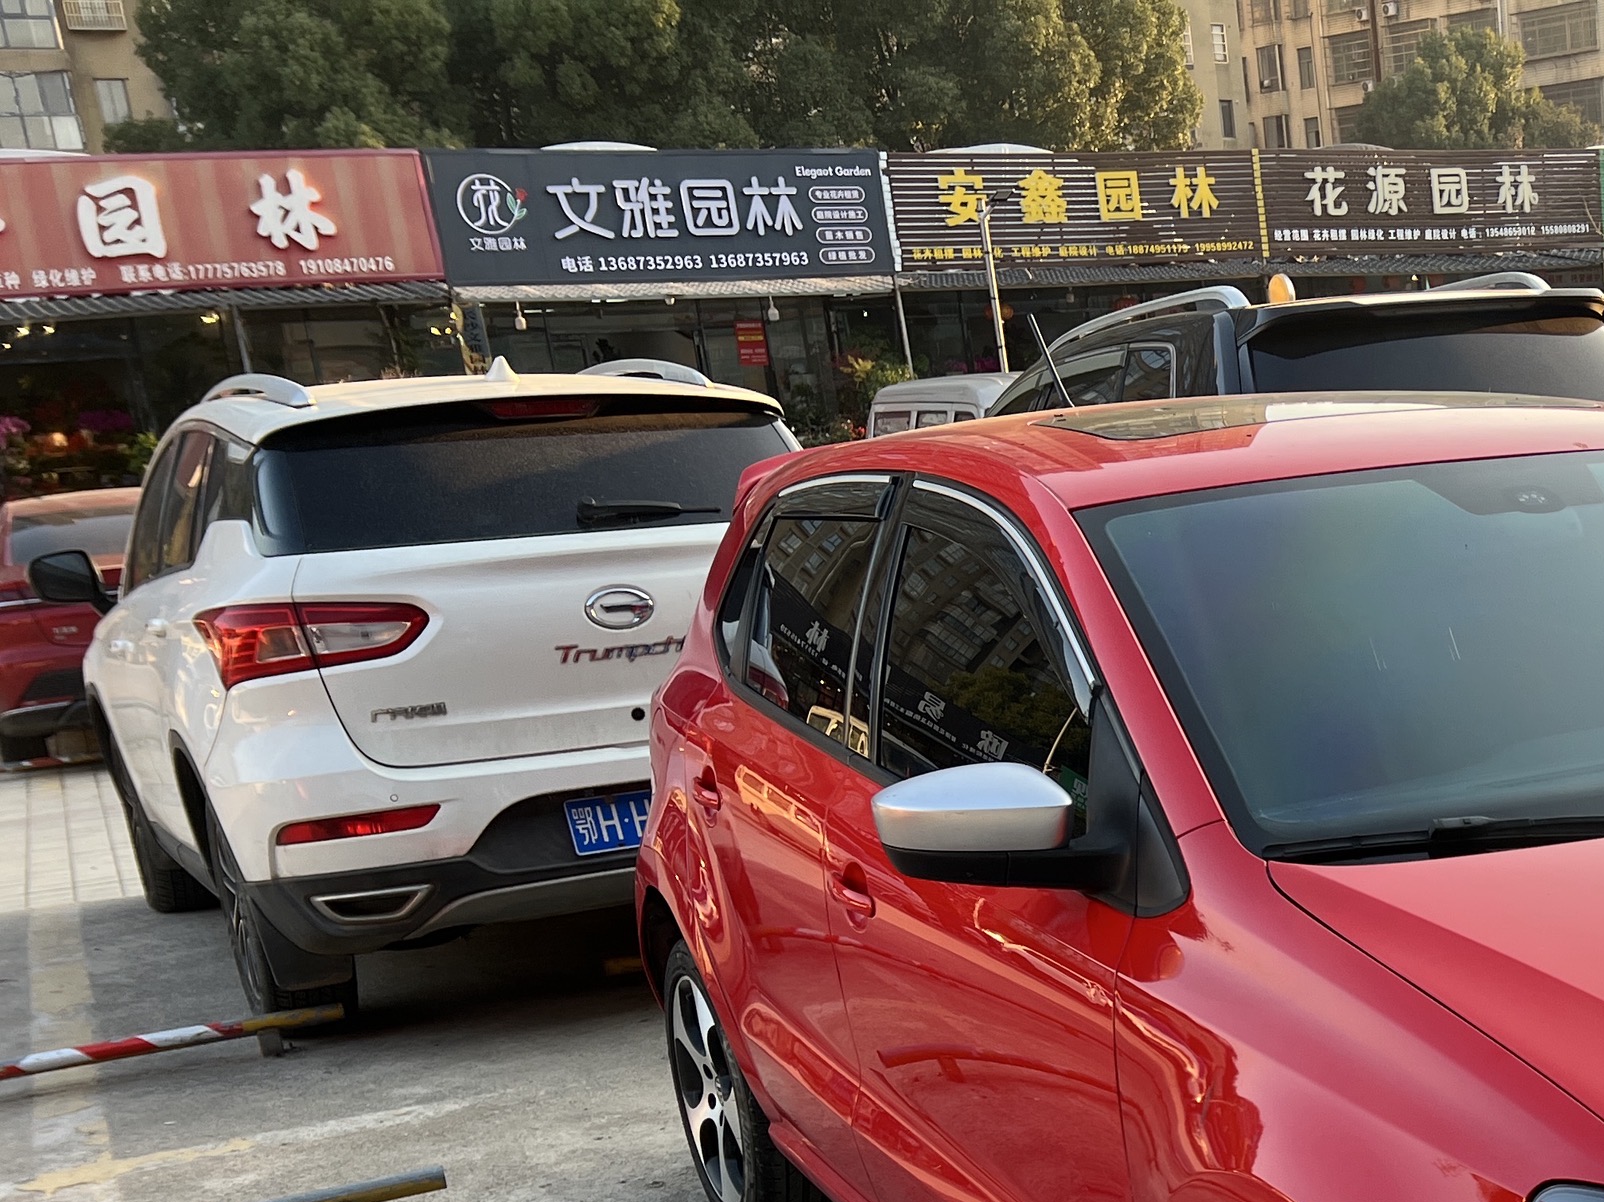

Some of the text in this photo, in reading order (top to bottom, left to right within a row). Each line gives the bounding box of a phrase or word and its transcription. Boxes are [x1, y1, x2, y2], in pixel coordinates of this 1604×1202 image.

[834, 165, 872, 178] Garden
[546, 176, 803, 239] 文雅园林
[938, 165, 1219, 226] 安鑫园林
[1304, 165, 1538, 217] 花源园林
[0, 169, 337, 258] 园林
[469, 236, 527, 251] 文雅园林
[962, 247, 1003, 259] 园林化
[32, 267, 97, 289] 绿化维护
[299, 255, 396, 275] 19108470476
[561, 251, 809, 273] 电话 13687352963 13687357963
